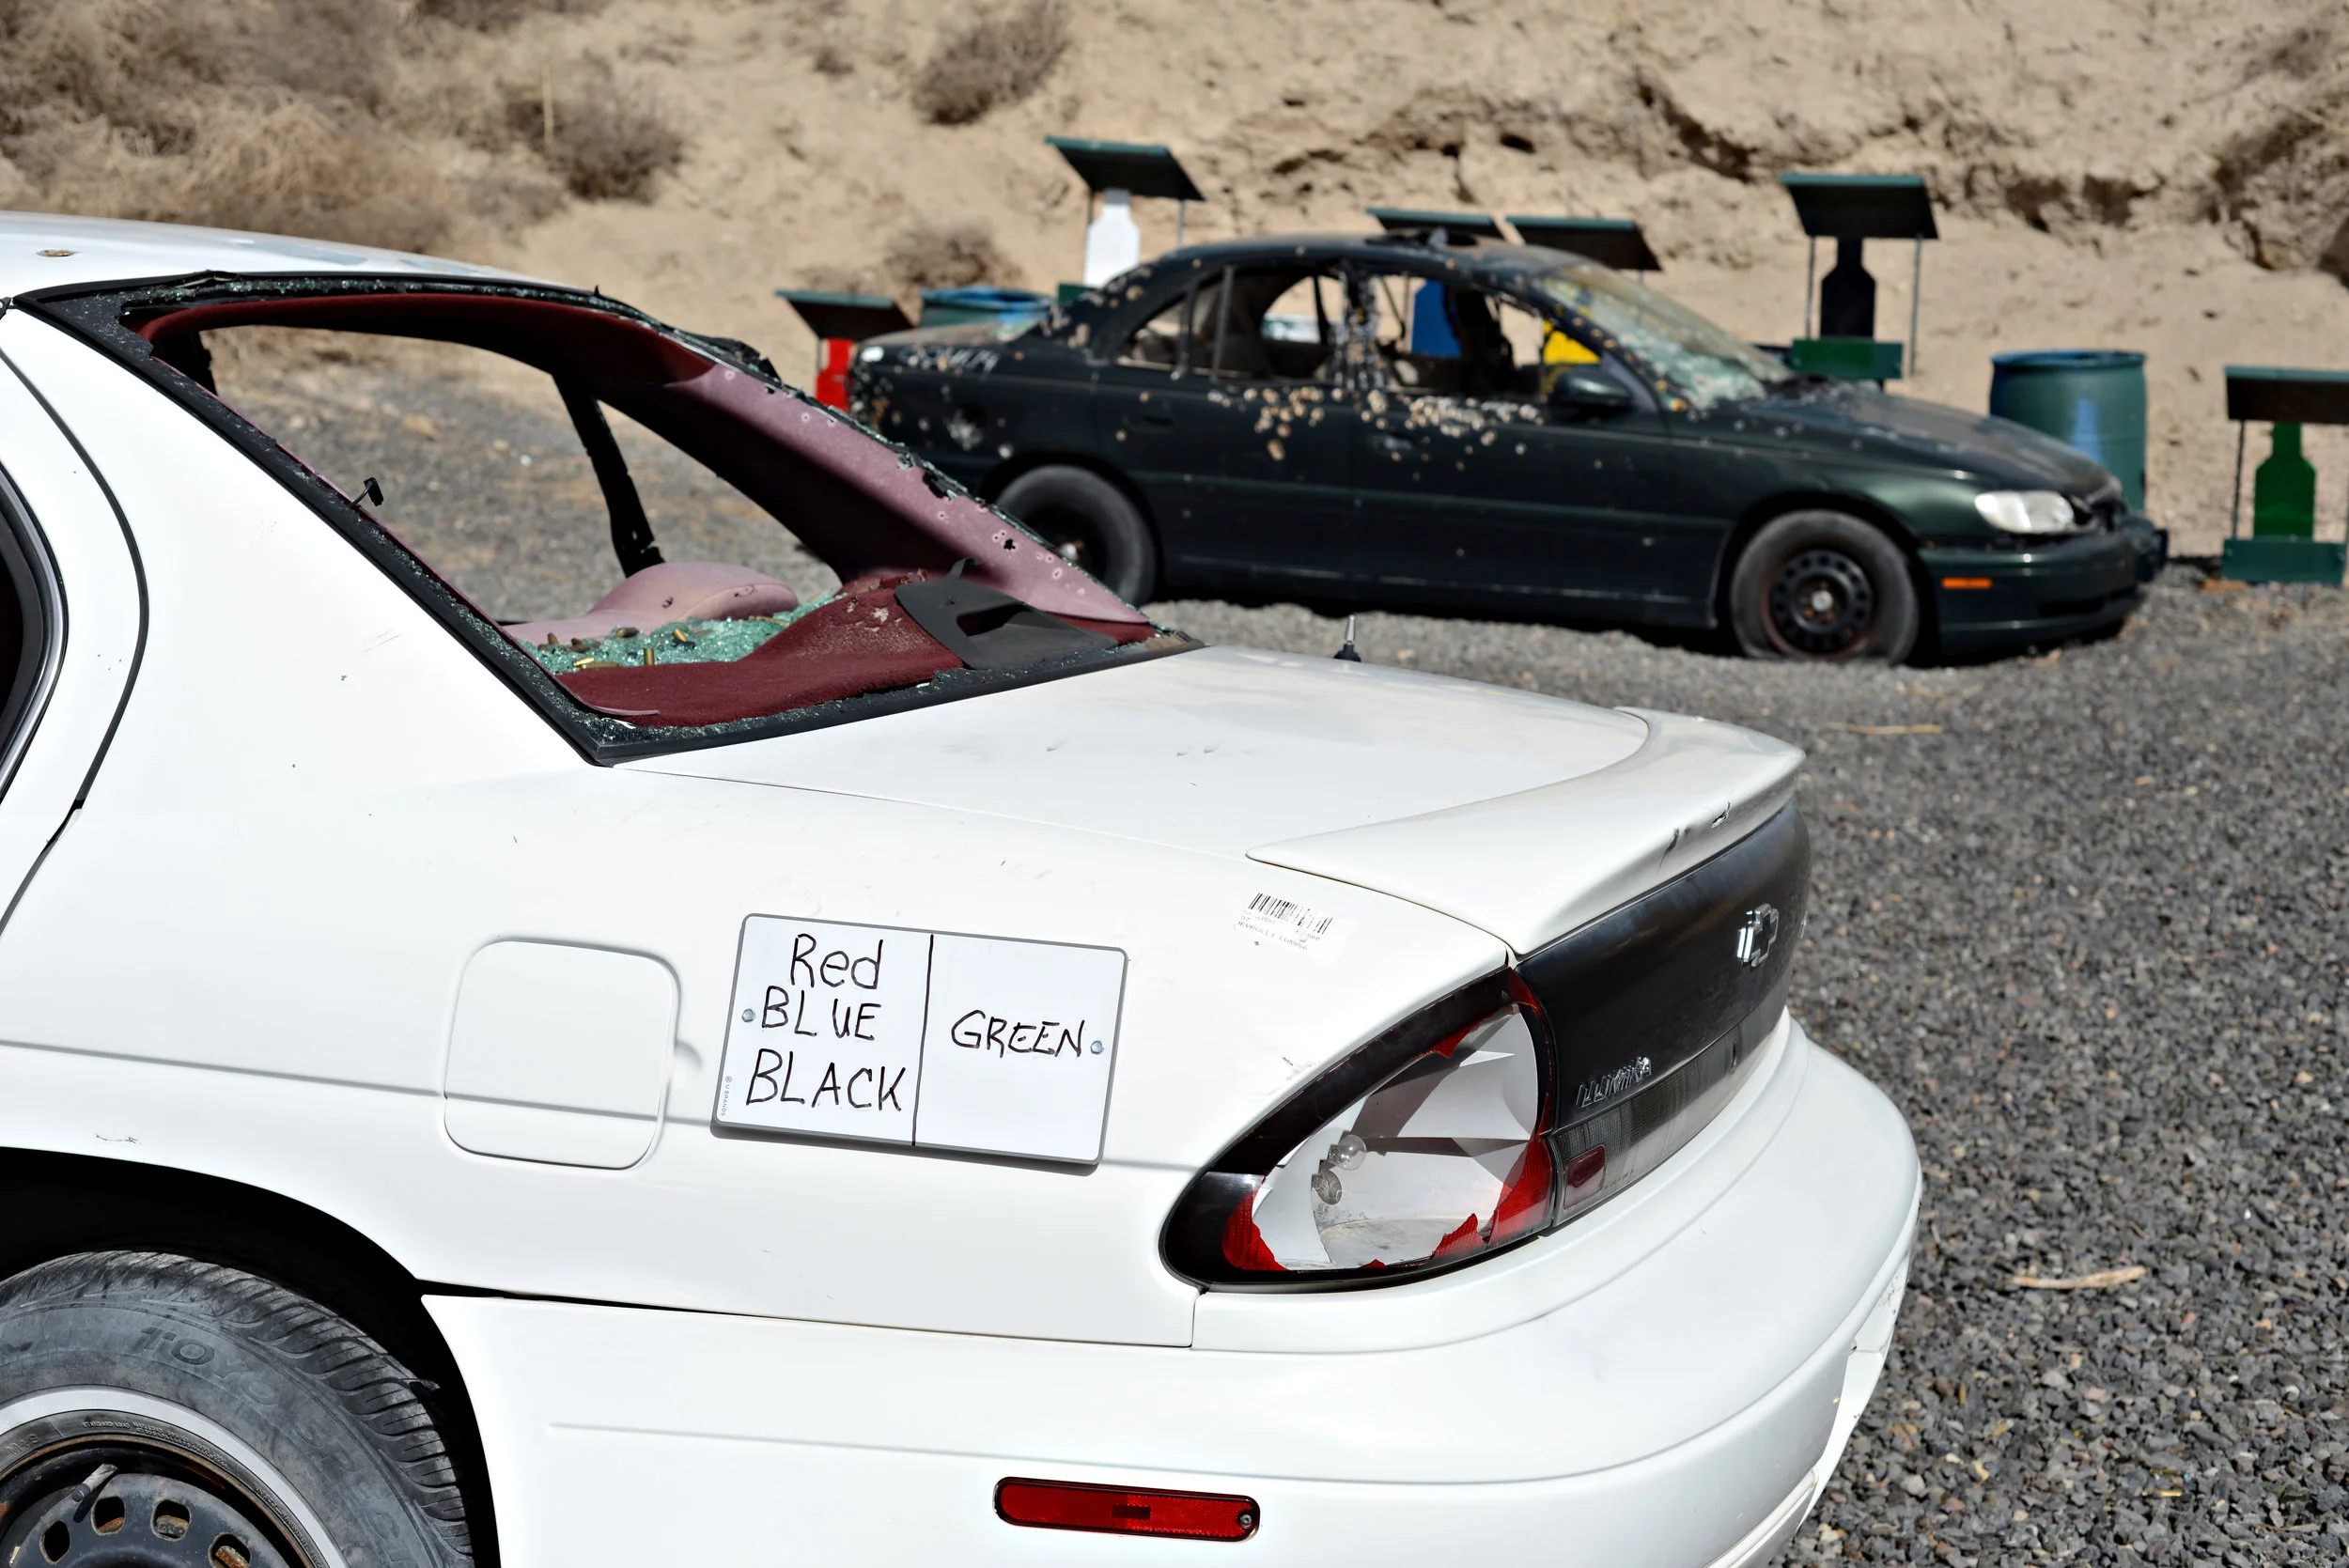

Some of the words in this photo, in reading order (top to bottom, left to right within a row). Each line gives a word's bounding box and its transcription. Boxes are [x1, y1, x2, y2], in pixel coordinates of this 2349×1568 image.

[791, 933, 883, 989] Red
[762, 986, 881, 1041] BLUE
[951, 1009, 1085, 1058] GREEN
[720, 1090, 729, 1116] BRANDS
[747, 1048, 906, 1111] BLACK
[130, 1326, 282, 1407] TOYO
